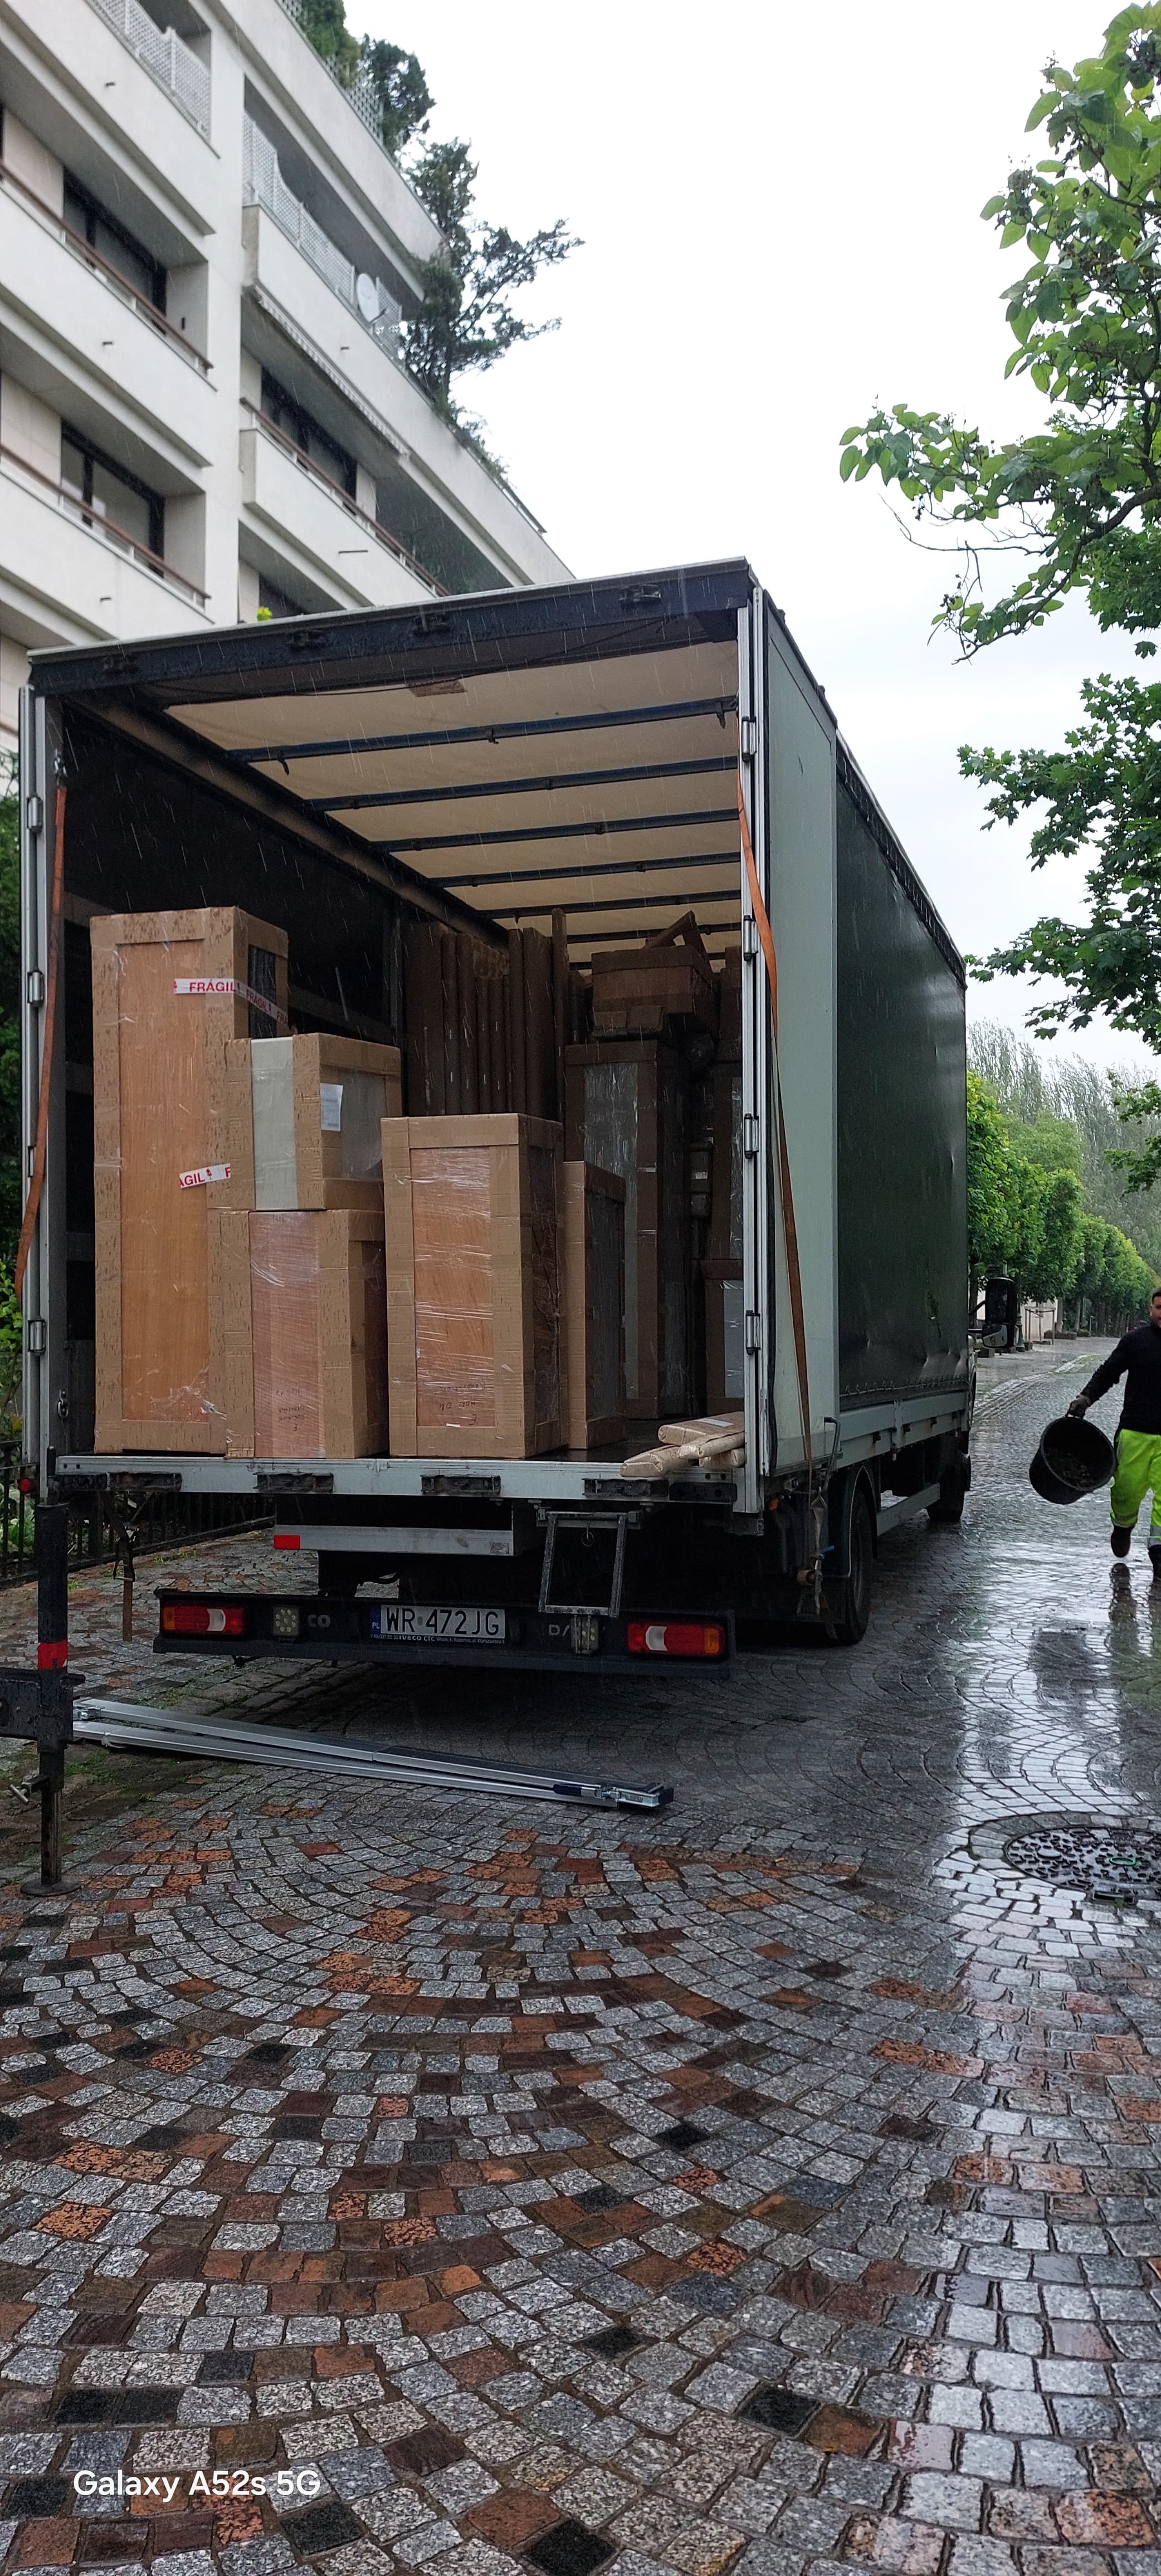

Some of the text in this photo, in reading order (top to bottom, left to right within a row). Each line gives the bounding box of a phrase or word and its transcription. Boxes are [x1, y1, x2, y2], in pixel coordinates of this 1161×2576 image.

[189, 979, 236, 992] FRÁGIL
[386, 1607, 499, 1636] WR 472JG
